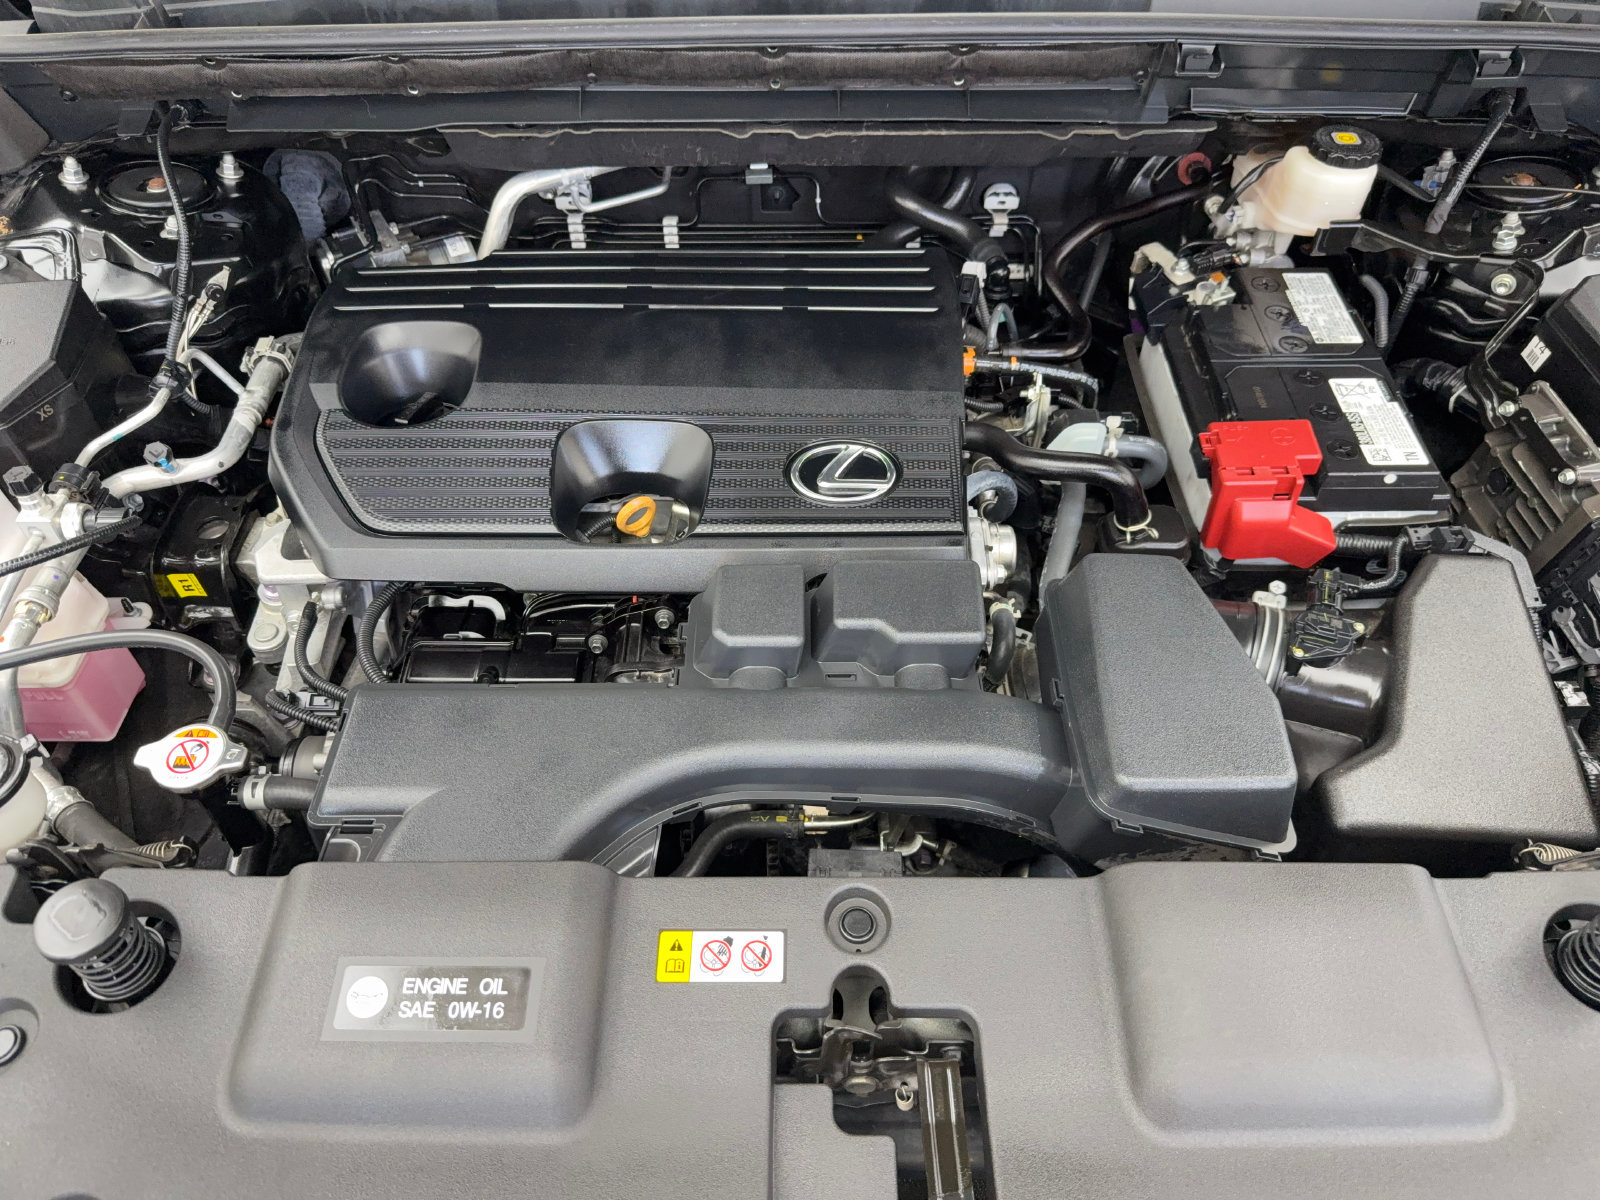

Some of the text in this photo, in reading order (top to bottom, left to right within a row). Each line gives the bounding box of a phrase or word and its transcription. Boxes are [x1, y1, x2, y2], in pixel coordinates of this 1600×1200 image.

[1403, 451, 1420, 461] TN
[178, 579, 195, 592] R1
[402, 977, 508, 995] ENGINE OIL
[398, 1000, 505, 1019] SAE 0W-16
